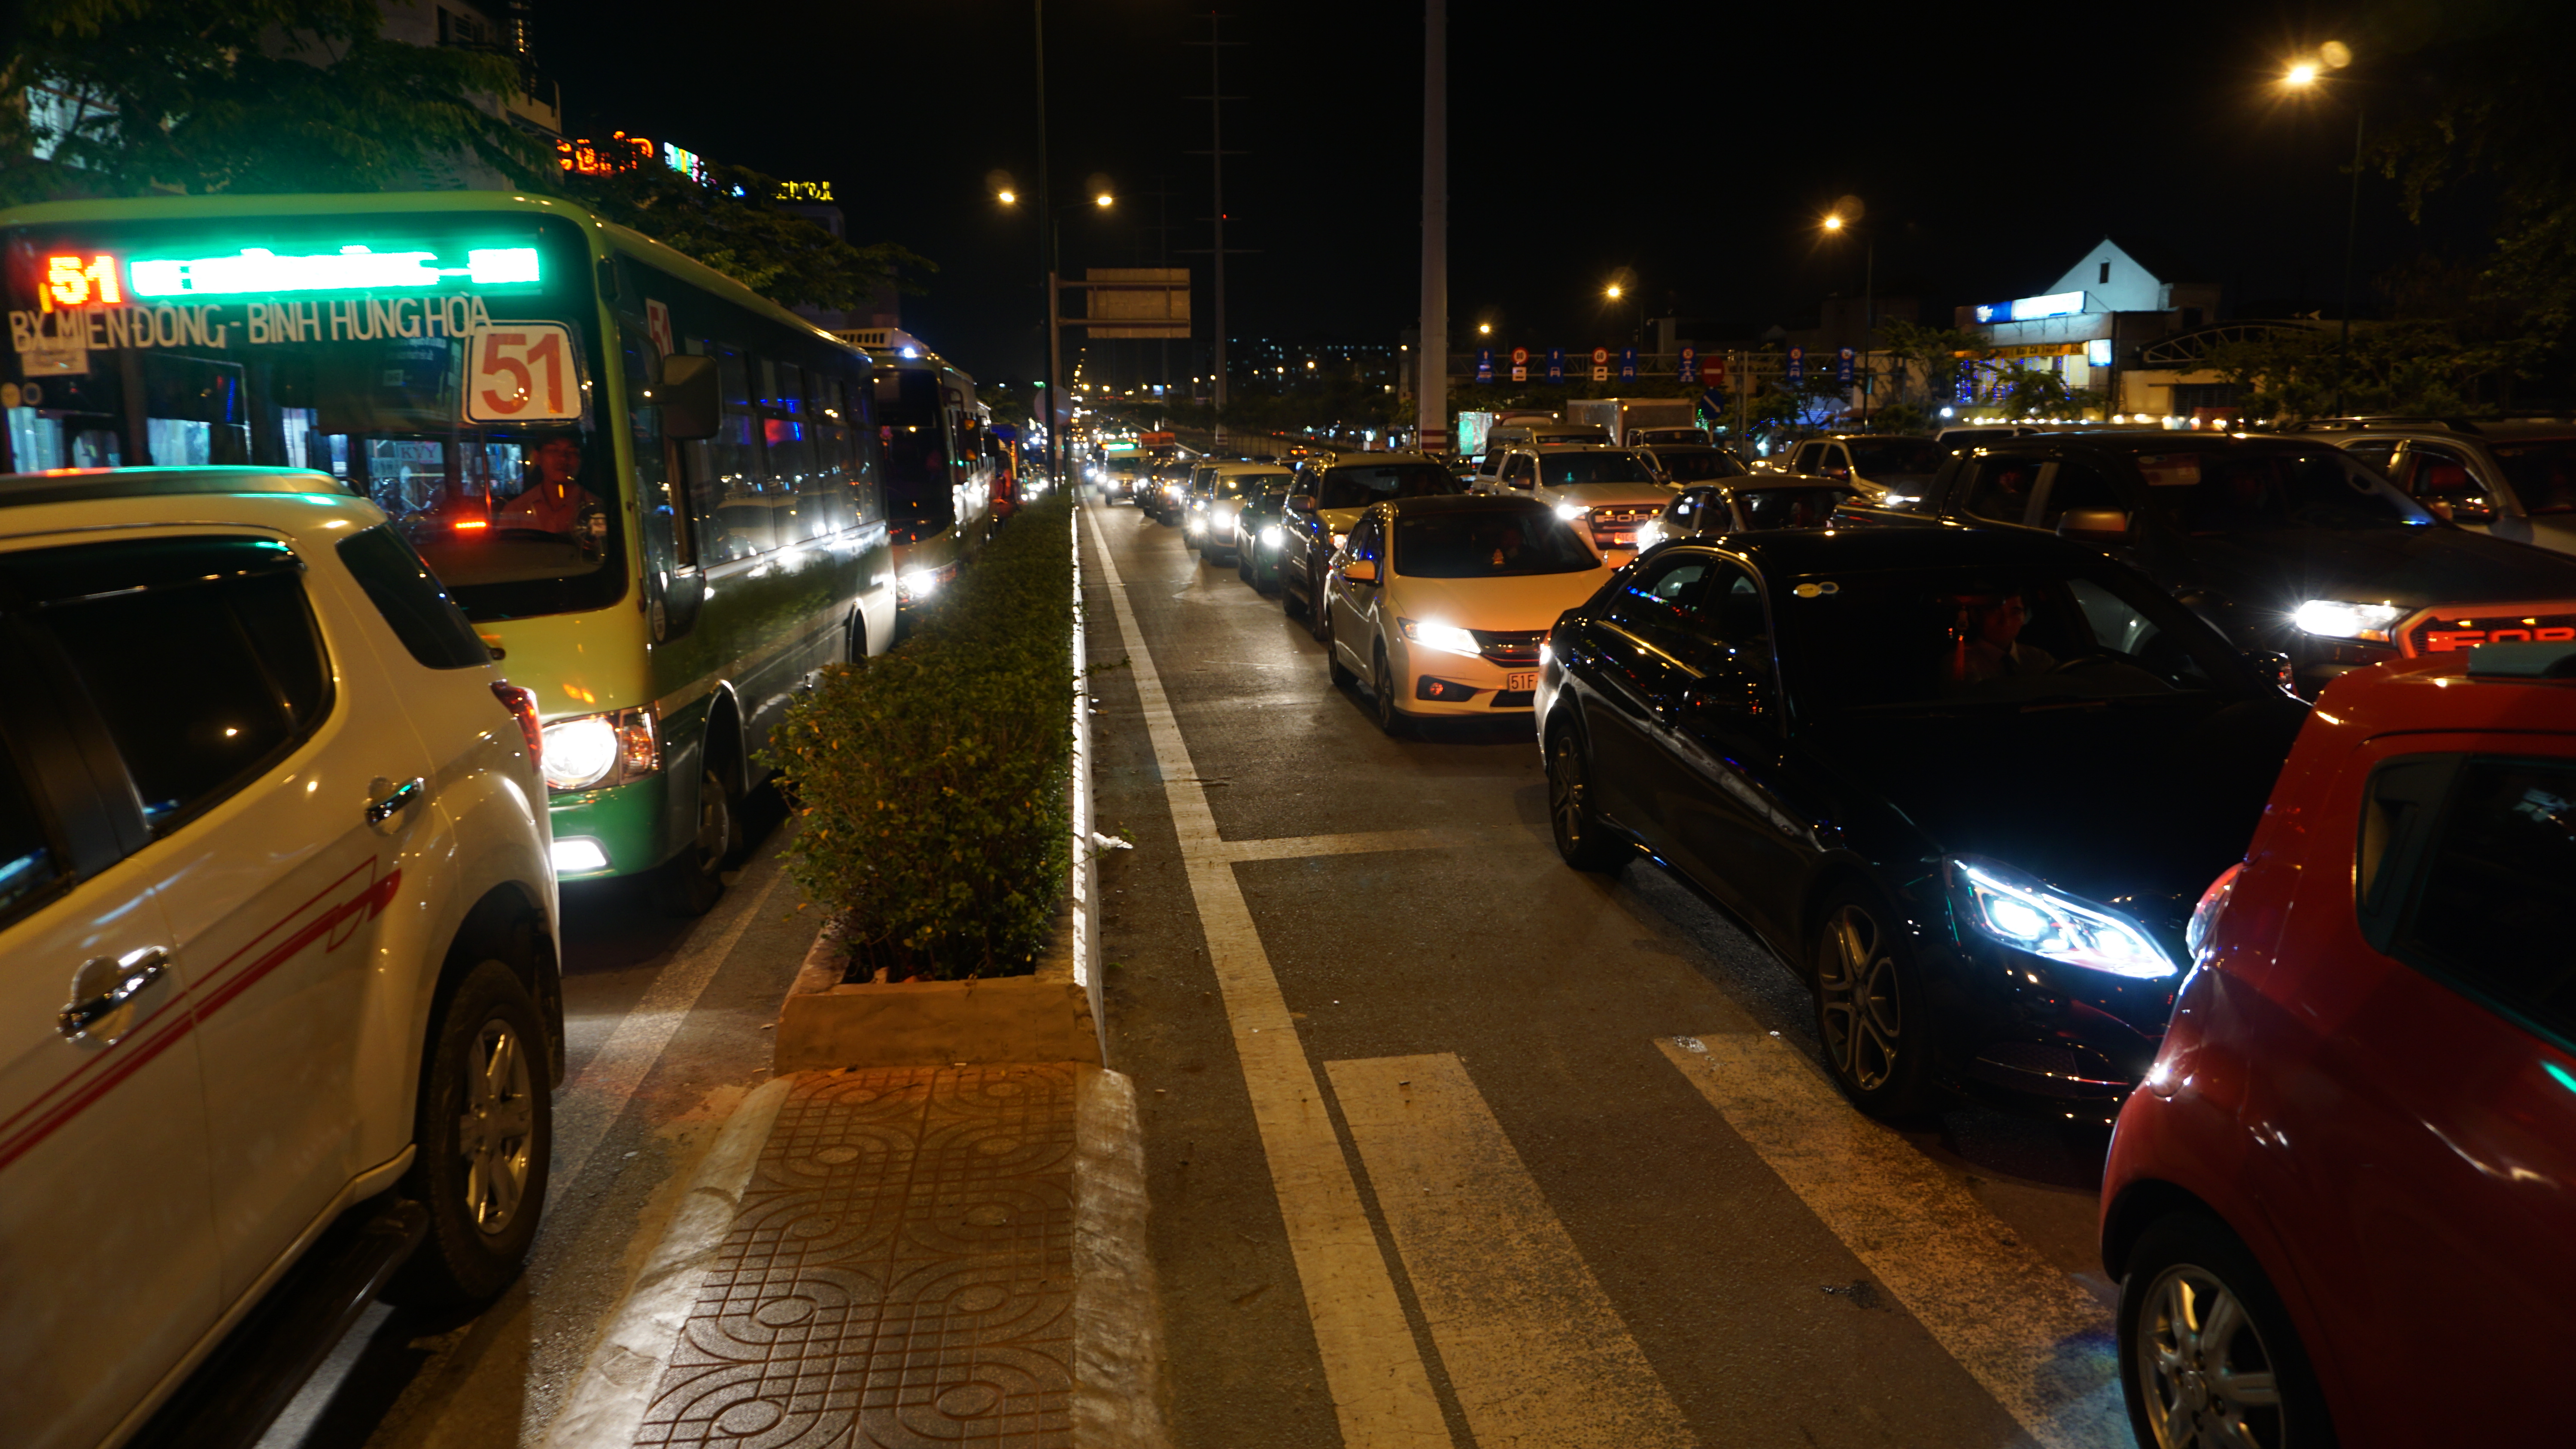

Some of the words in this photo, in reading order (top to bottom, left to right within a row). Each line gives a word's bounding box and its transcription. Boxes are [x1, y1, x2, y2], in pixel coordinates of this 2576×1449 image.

[49, 256, 122, 304] 51
[9, 310, 48, 353] BX
[131, 299, 227, 349] ĐÔNG
[247, 296, 321, 343] BÌNH
[329, 291, 422, 341] HƯNG
[424, 291, 493, 338] HÒA
[481, 333, 564, 414] 51
